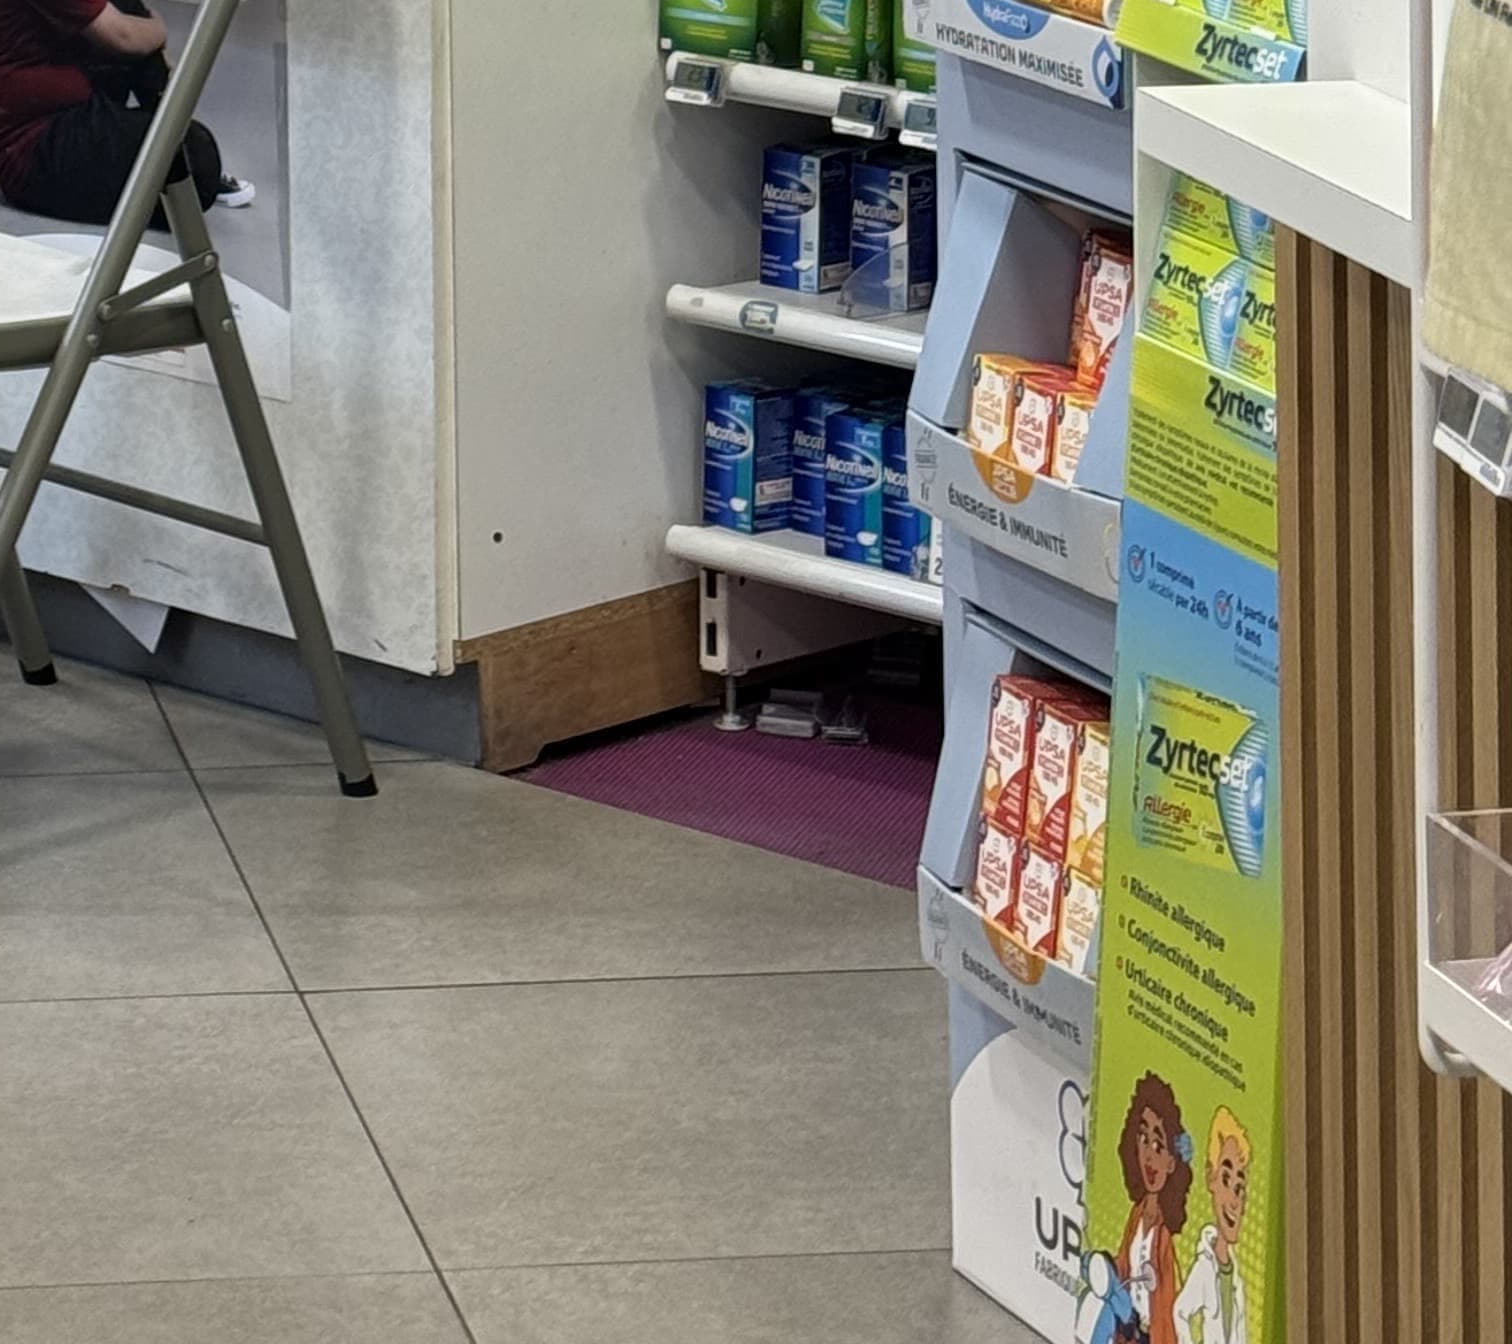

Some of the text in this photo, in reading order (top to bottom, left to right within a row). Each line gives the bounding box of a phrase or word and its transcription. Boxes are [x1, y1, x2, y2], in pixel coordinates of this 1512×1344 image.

[936, 23, 1084, 87] HYDRATATION MAXIMISÉE
[1196, 23, 1287, 81] Zyrtecset
[1205, 376, 1276, 434] Zyrtecs
[948, 482, 1068, 558] ÉNERGIE & IMMUNITÉ
[1146, 723, 1253, 792] Zyrtecset
[1129, 876, 1226, 953] Rhinite allergique
[1125, 957, 1229, 1043] Urticaire chronique
[1126, 917, 1257, 1017] Conjonctivite allergique
